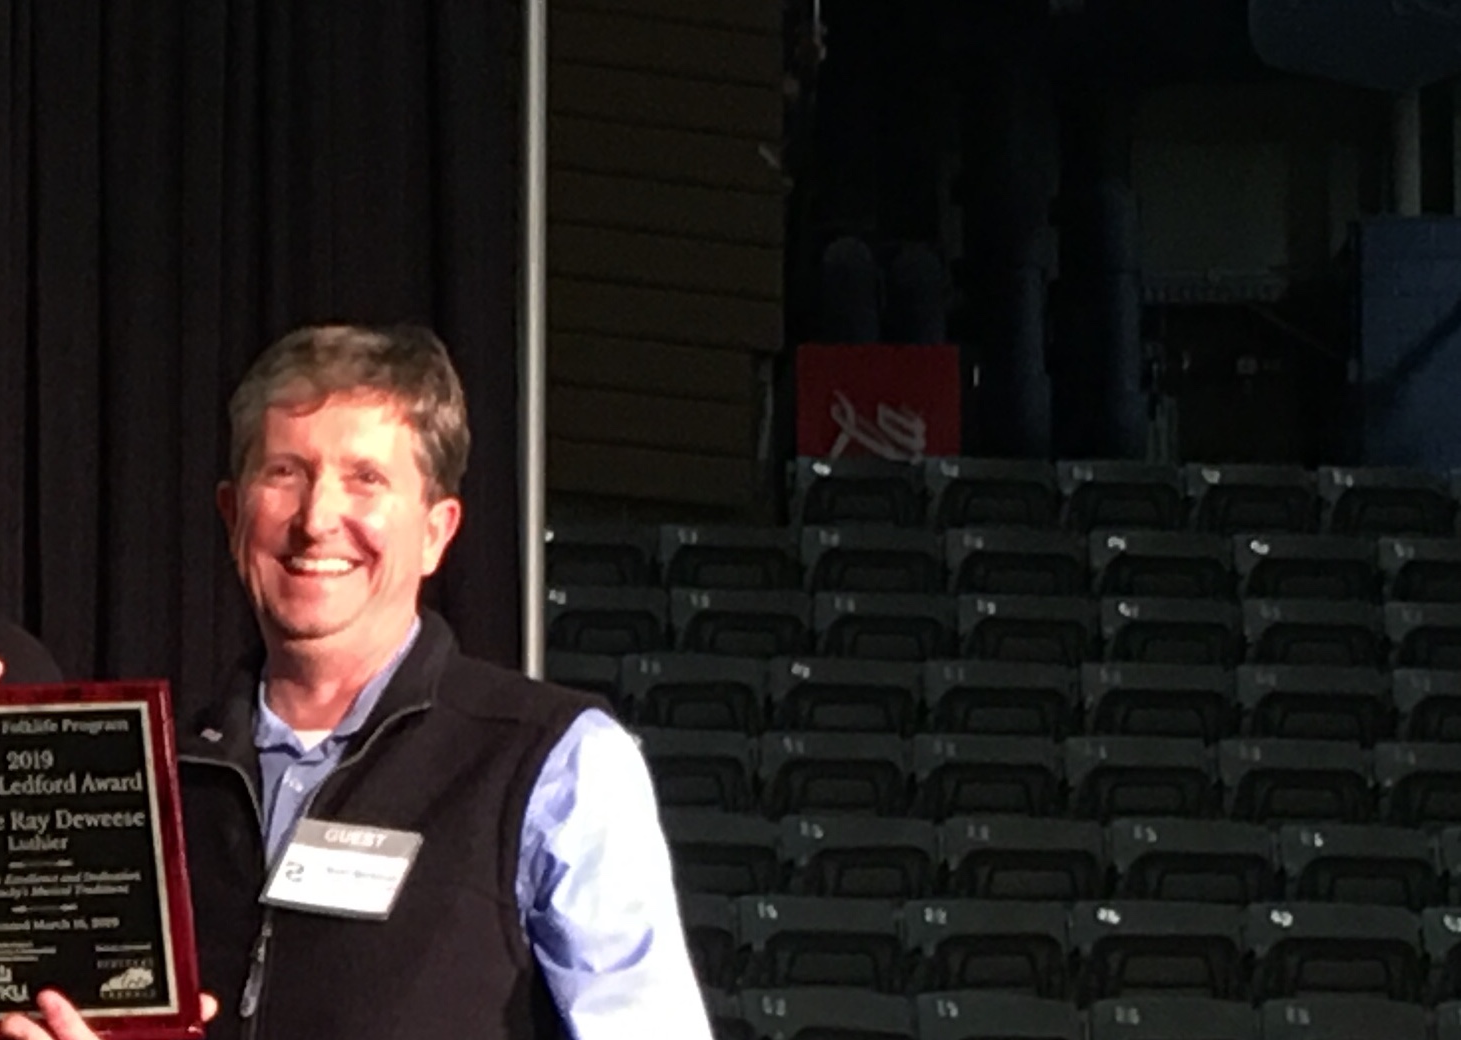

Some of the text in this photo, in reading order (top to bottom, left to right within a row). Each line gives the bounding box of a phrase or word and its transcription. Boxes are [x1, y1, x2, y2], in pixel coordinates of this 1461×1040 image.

[62, 718, 129, 734] Program
[6, 750, 54, 770] 2019
[81, 768, 143, 791] Award
[10, 811, 50, 834] Ray
[324, 828, 387, 847] GUEST
